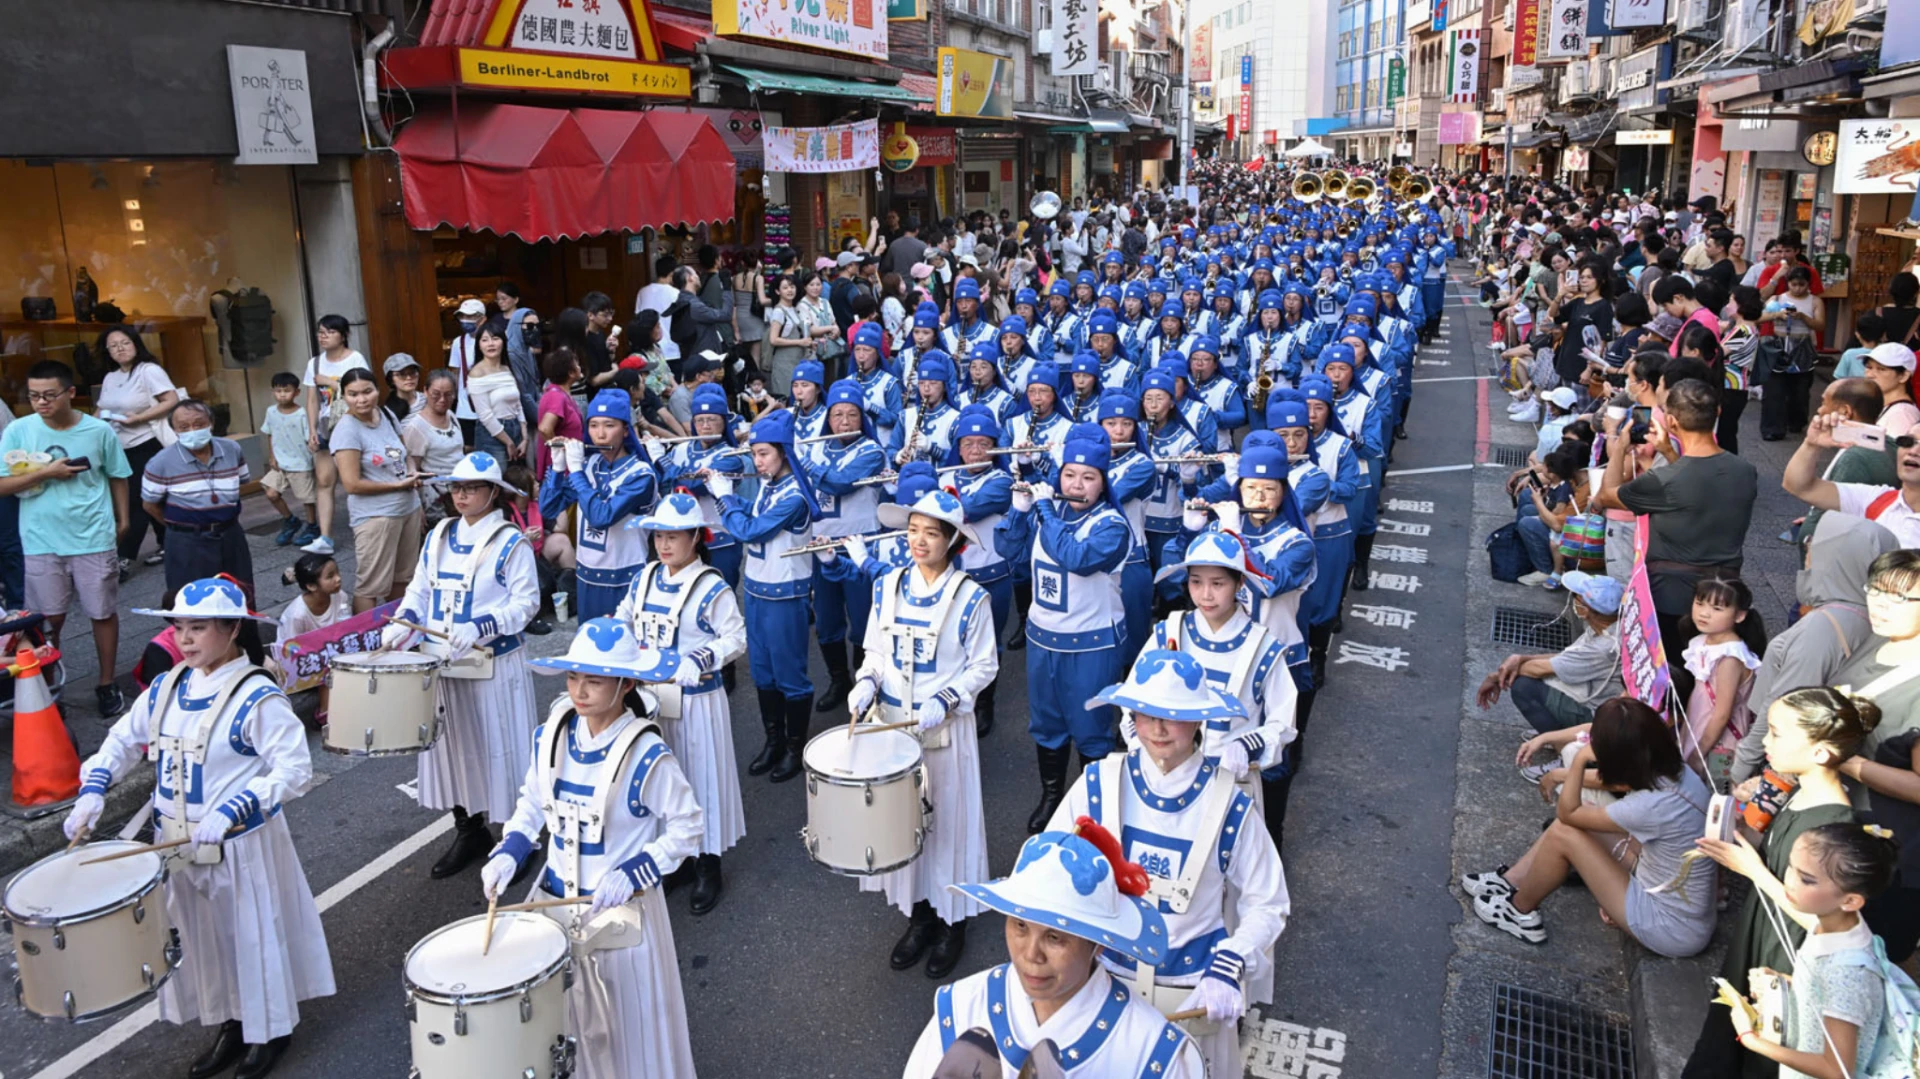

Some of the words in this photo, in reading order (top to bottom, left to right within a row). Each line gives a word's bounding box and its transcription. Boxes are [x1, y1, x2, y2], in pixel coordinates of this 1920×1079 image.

[521, 14, 629, 51] 德國農夫麵包
[791, 17, 821, 39] River
[824, 24, 850, 45] Light
[478, 62, 610, 83] Berliner-Landbrot
[1041, 576, 1058, 599] 樂
